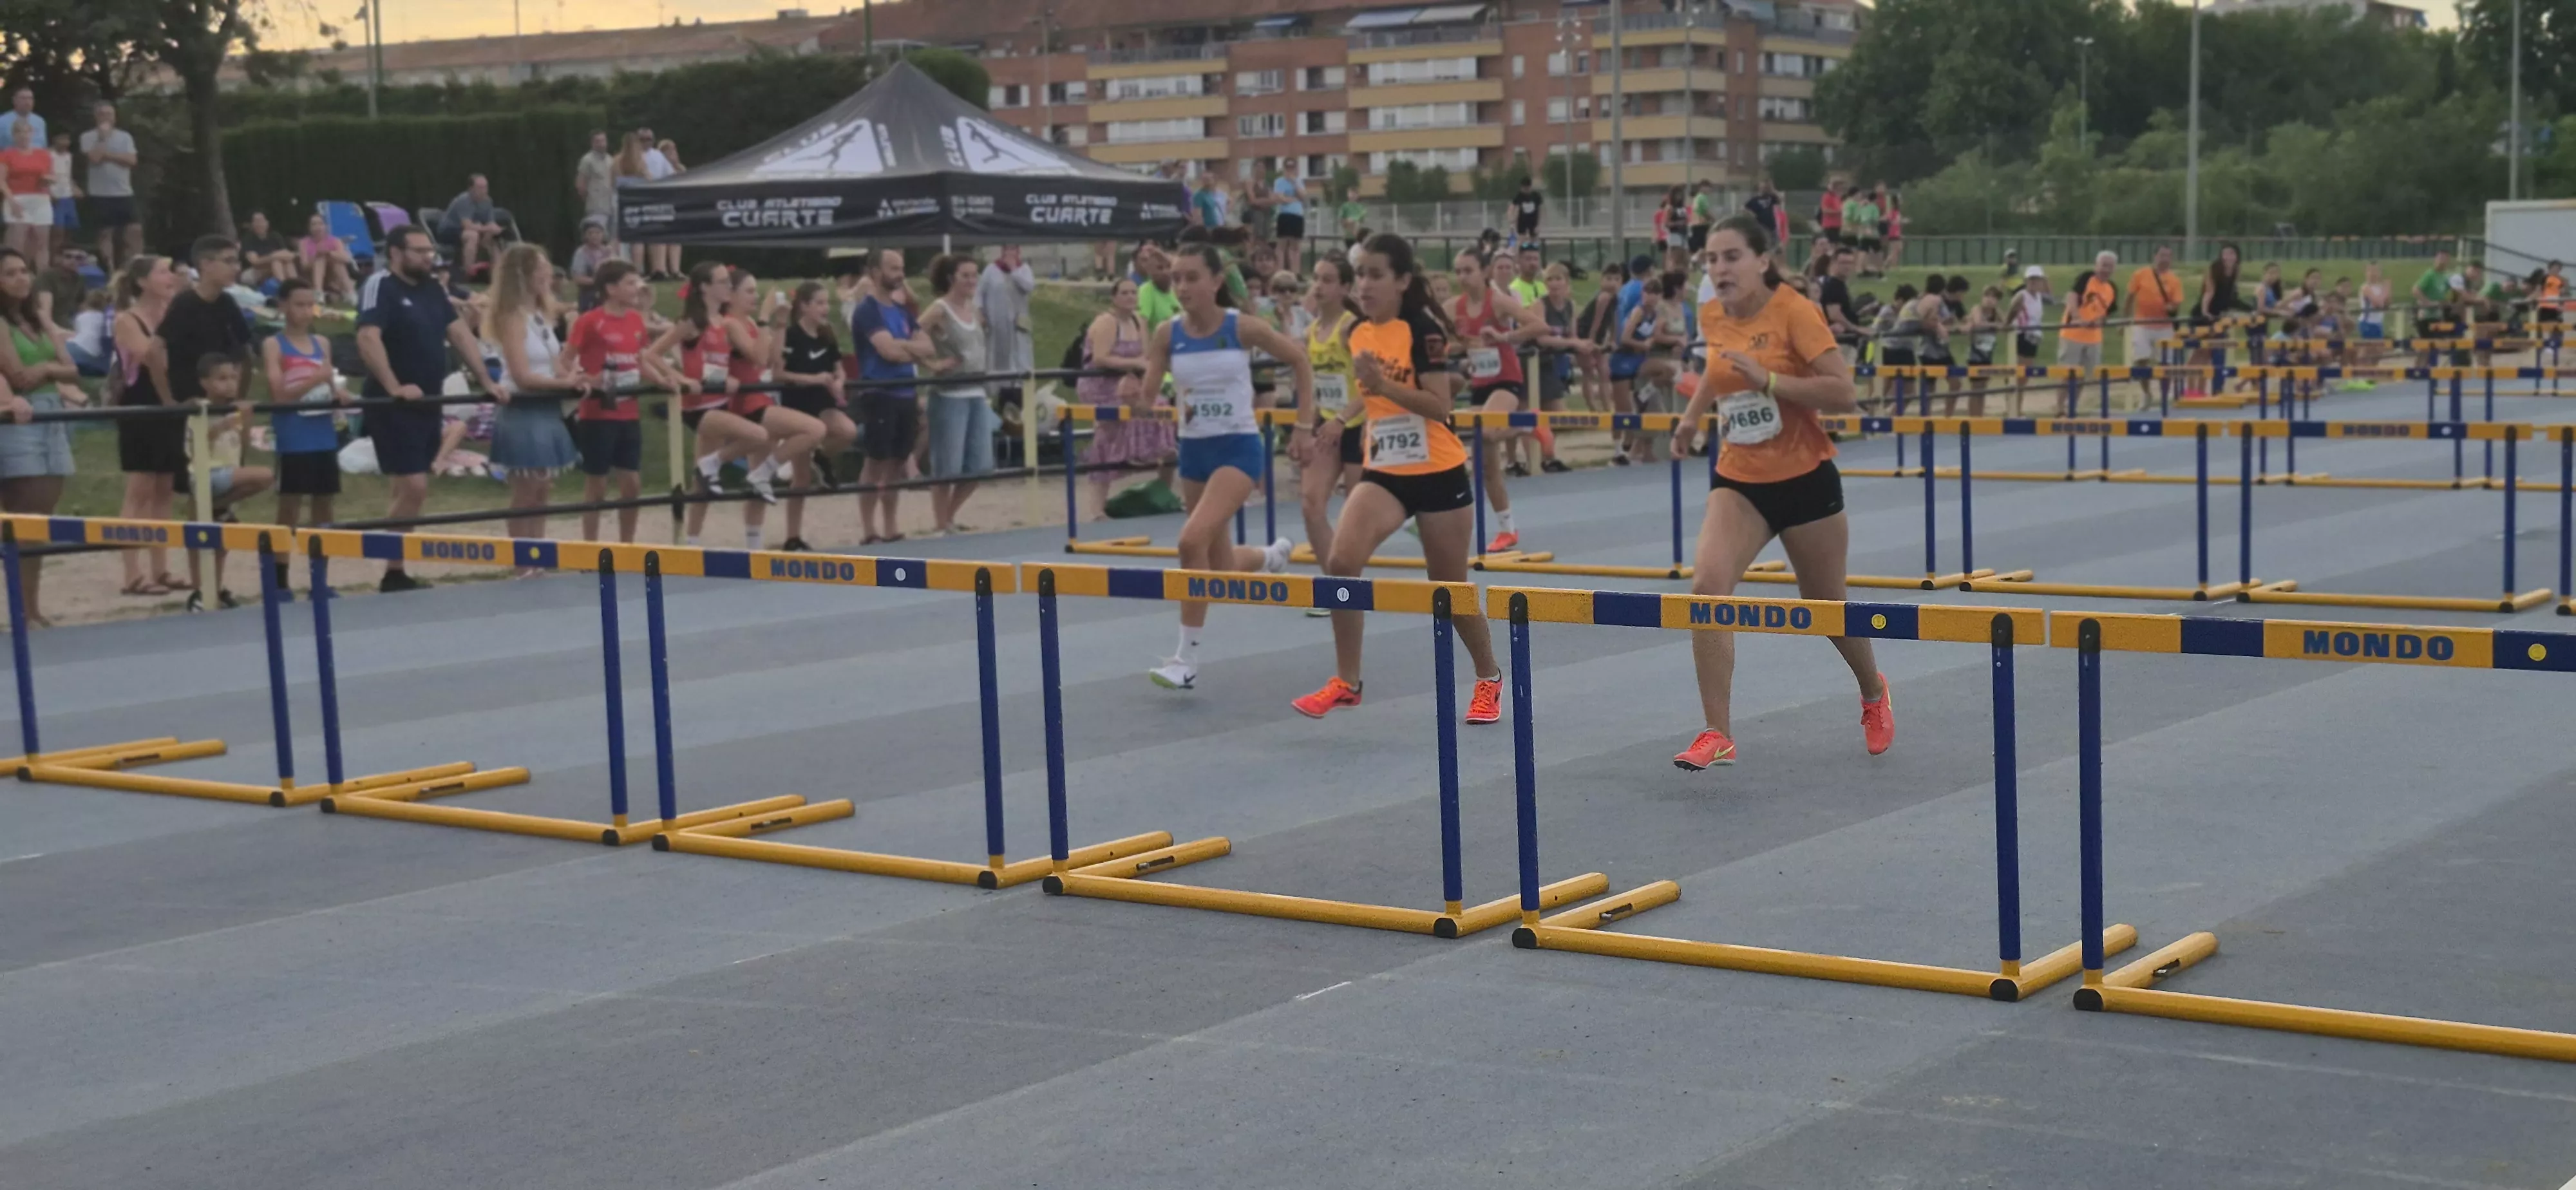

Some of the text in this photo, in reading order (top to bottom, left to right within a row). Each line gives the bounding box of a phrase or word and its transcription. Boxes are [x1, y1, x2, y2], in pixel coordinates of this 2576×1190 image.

[717, 198, 758, 210] CLUB
[1025, 194, 1057, 205] CLUB
[721, 209, 835, 229] CUARTE
[1030, 207, 1113, 227] CUARTE
[1192, 402, 1235, 418] 1592
[1729, 406, 1774, 430] 1686
[1377, 432, 1421, 451] 1792
[421, 540, 496, 561] MONDO
[770, 558, 855, 581] MONDO
[1188, 577, 1288, 602] MONDO
[1690, 601, 1812, 629] MONDO
[2304, 630, 2454, 661] MONDO
